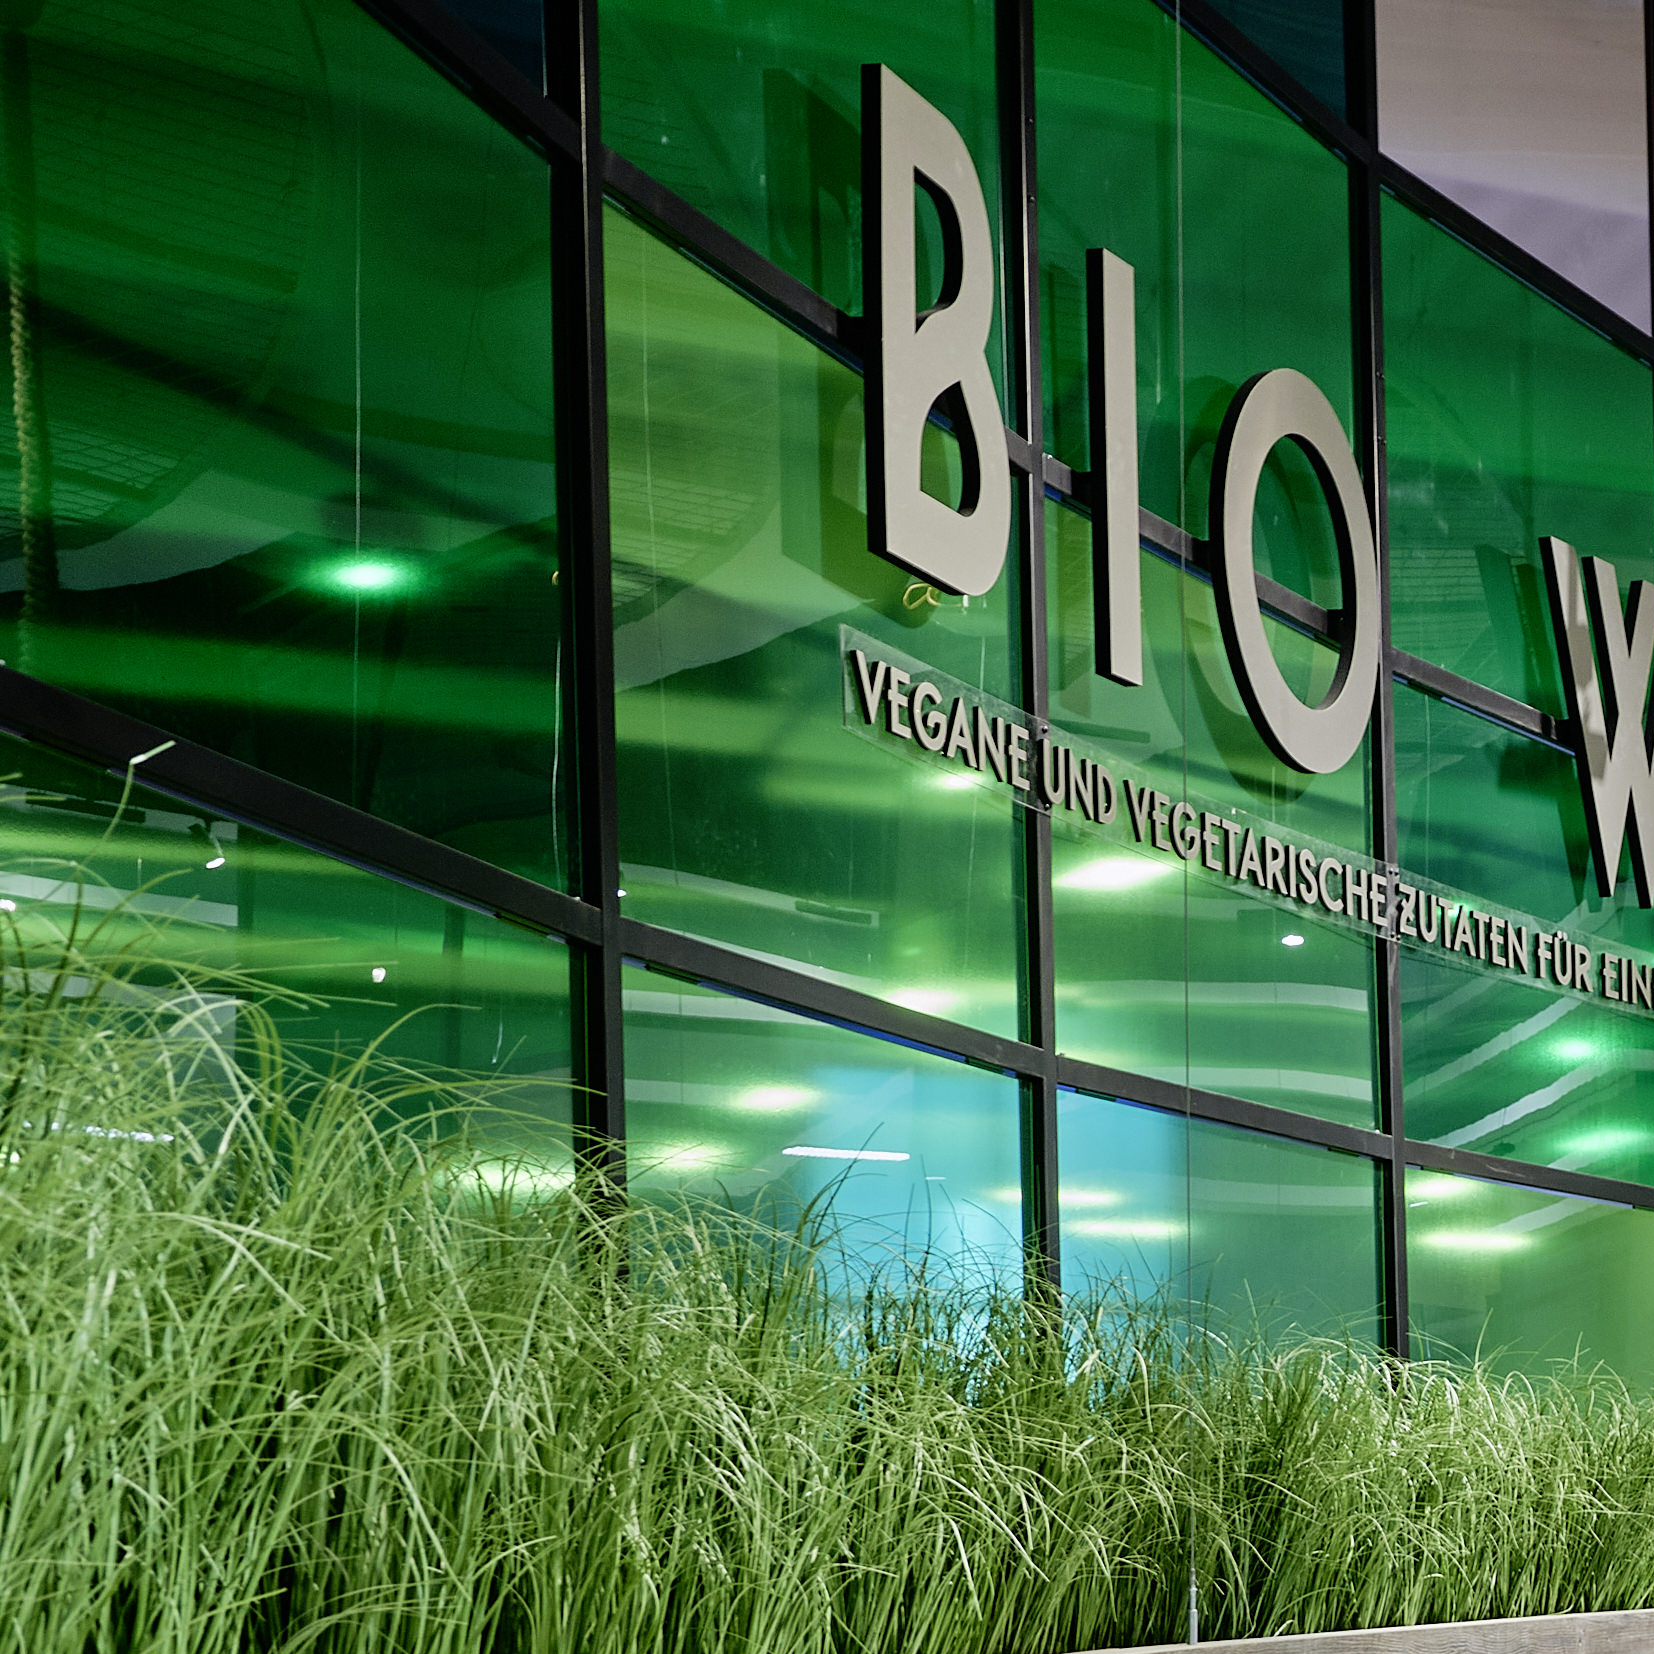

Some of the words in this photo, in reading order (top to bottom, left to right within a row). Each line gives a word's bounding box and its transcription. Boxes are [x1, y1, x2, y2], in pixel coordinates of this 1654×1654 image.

[861, 62, 1381, 774] BIO
[850, 649, 1031, 790] VEGANE
[1042, 738, 1116, 824] UND
[1124, 779, 1388, 926] VEGETARISCHE
[1398, 884, 1528, 974] ZUTATEN
[1536, 931, 1593, 993] FÜR
